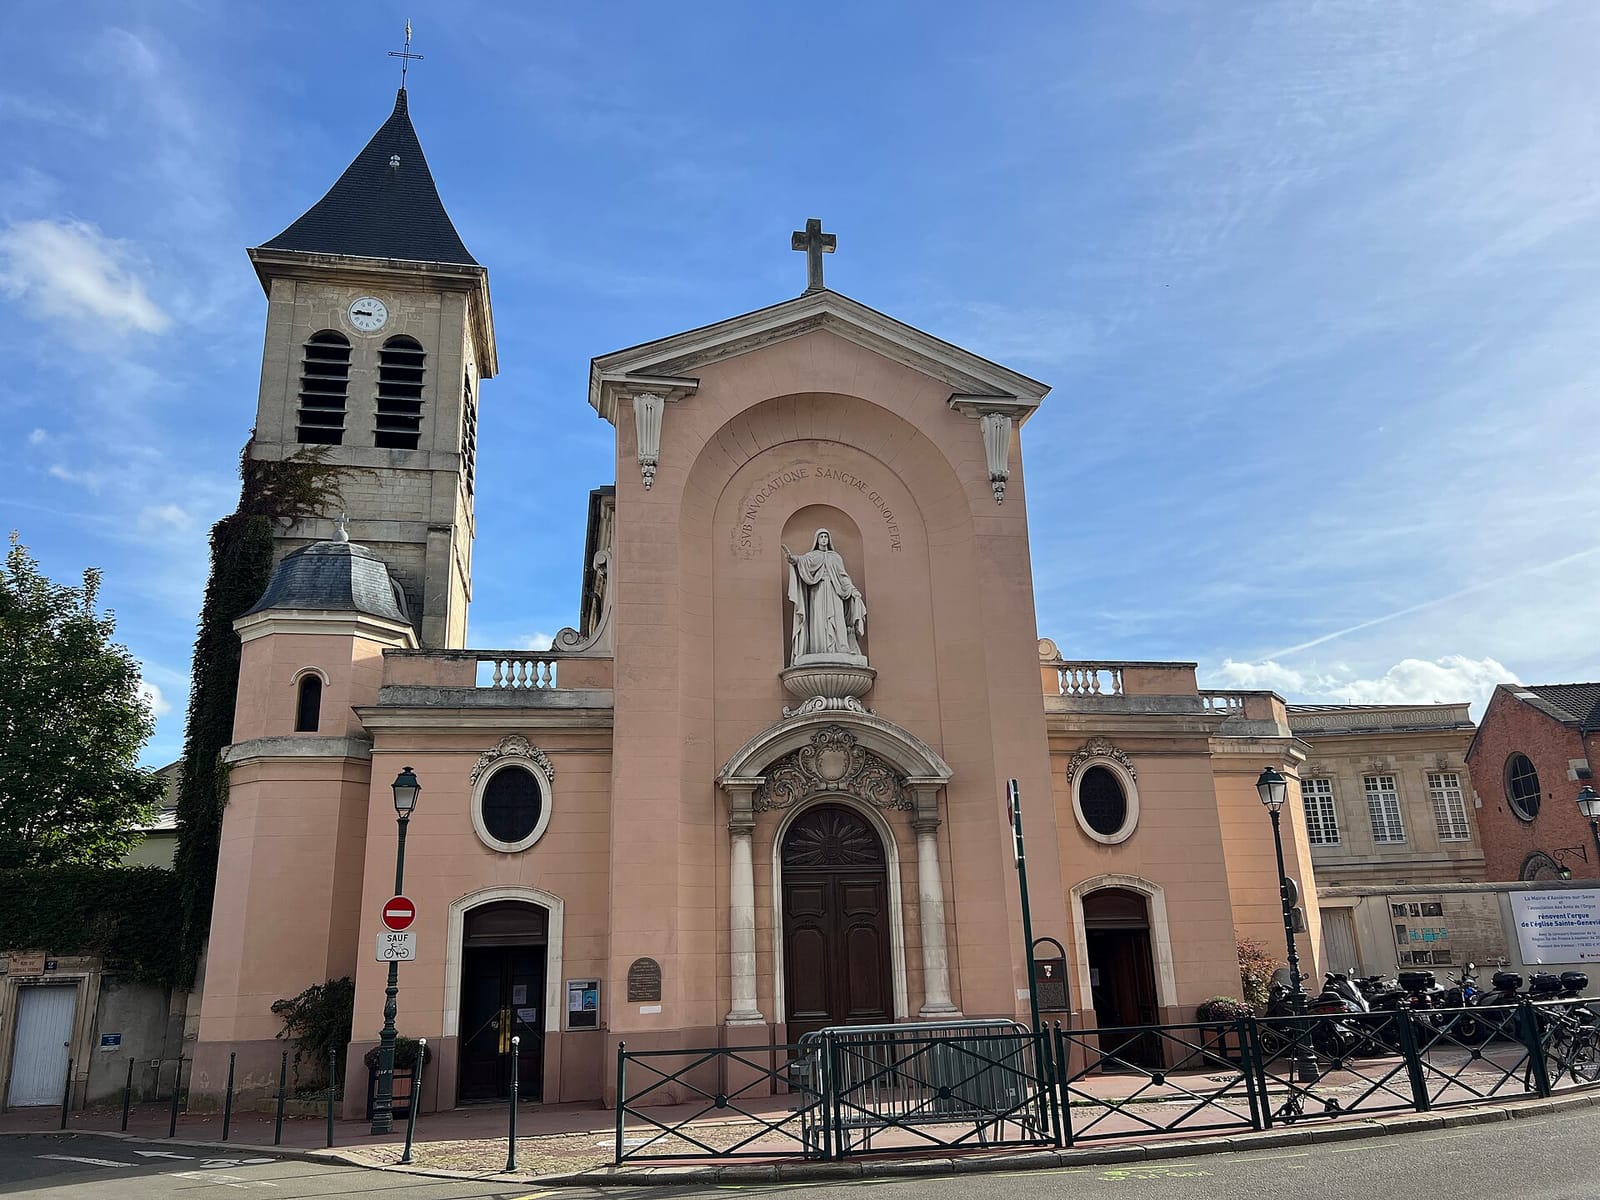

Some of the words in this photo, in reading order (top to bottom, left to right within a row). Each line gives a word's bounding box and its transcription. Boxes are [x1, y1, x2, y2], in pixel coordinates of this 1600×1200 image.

[745, 468, 809, 520] INVOCATIONE
[1538, 912, 1567, 920] rénovent
[1567, 912, 1590, 920] l'orgue
[1530, 920, 1554, 928] l'église
[387, 934, 408, 942] SAUF
